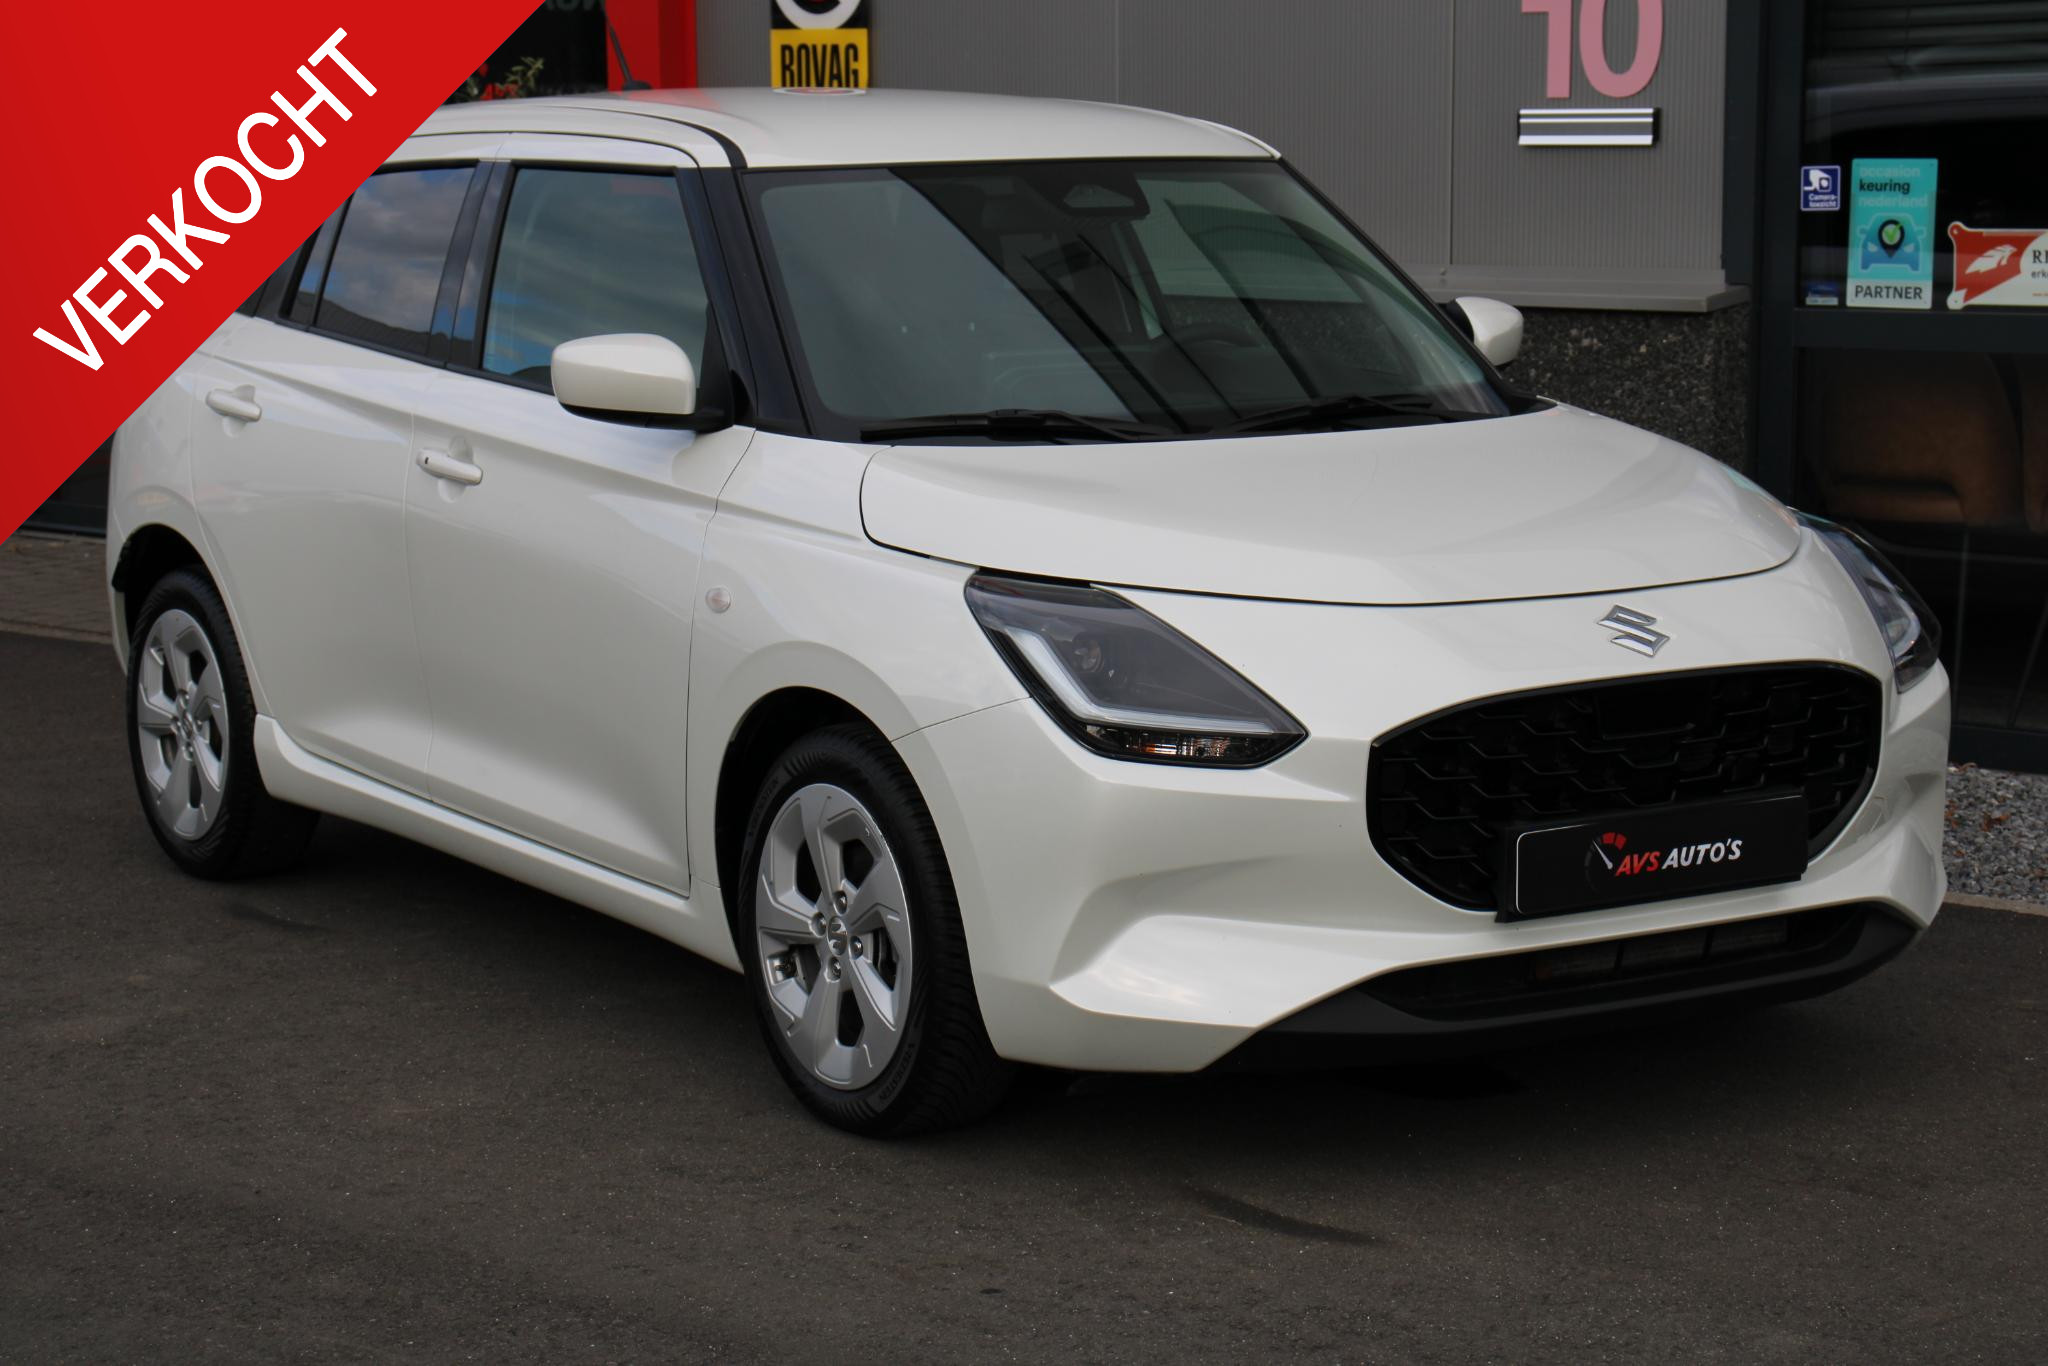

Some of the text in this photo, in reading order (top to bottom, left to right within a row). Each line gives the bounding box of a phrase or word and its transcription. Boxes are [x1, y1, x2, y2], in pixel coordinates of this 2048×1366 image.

[780, 43, 859, 88] BOVAG
[1521, 0, 1663, 98] 10
[1859, 179, 1910, 195] keuring
[1855, 285, 1923, 300] PARTNER
[1615, 838, 1743, 876] AVS AUTO'S
